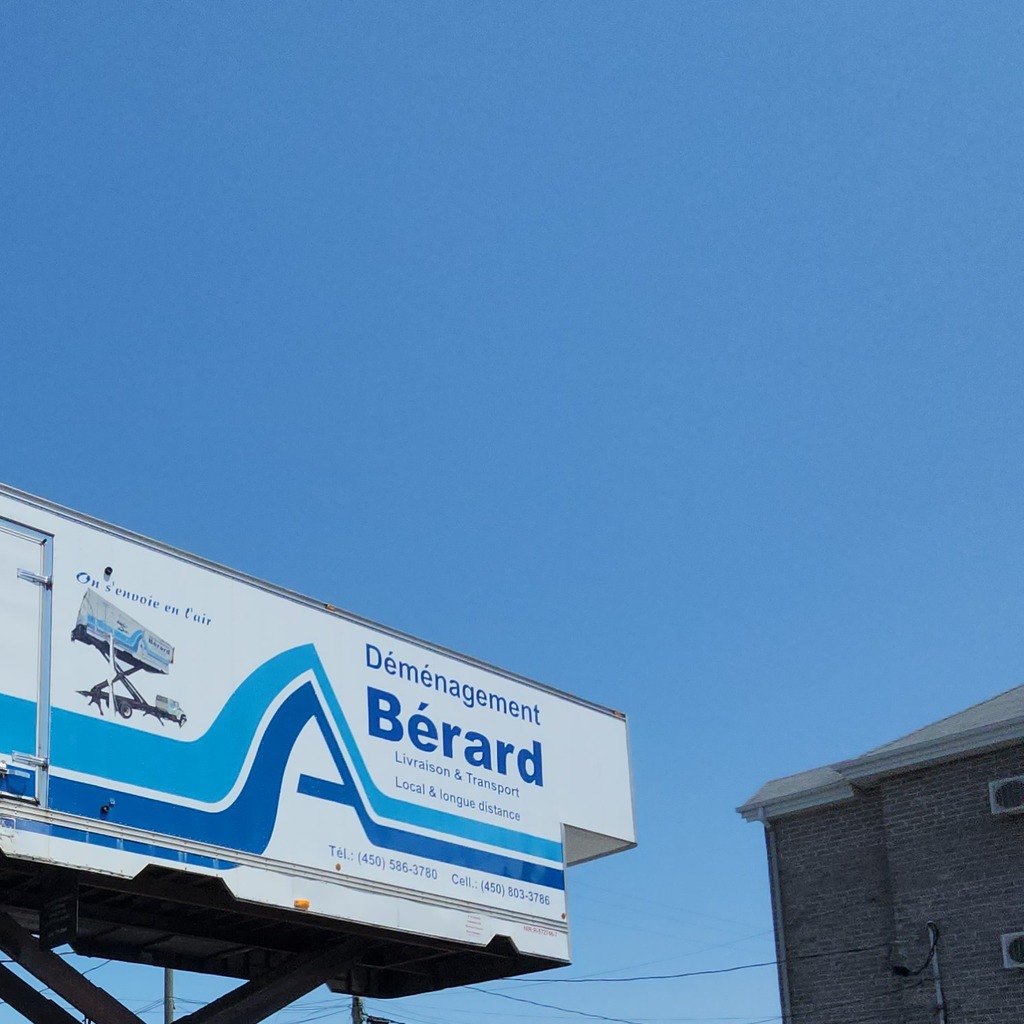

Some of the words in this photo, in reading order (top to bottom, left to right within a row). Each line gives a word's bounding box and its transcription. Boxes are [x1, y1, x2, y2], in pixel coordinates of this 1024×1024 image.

[76, 572, 99, 589] On
[106, 581, 160, 609] s'envoie
[165, 604, 179, 615] en
[185, 607, 212, 626] l'air
[365, 643, 540, 726] Déménagement
[367, 685, 544, 787] Bérard
[395, 751, 450, 777] Livraison
[454, 768, 462, 781] &
[466, 772, 520, 798] Transport
[395, 776, 425, 795] Local
[429, 785, 436, 797] &
[440, 788, 475, 808] longue
[479, 801, 521, 821] distance
[358, 852, 386, 871] (450)
[389, 859, 438, 880] 586-3780
[481, 880, 505, 897] (450)
[508, 886, 550, 905] 803-3786
